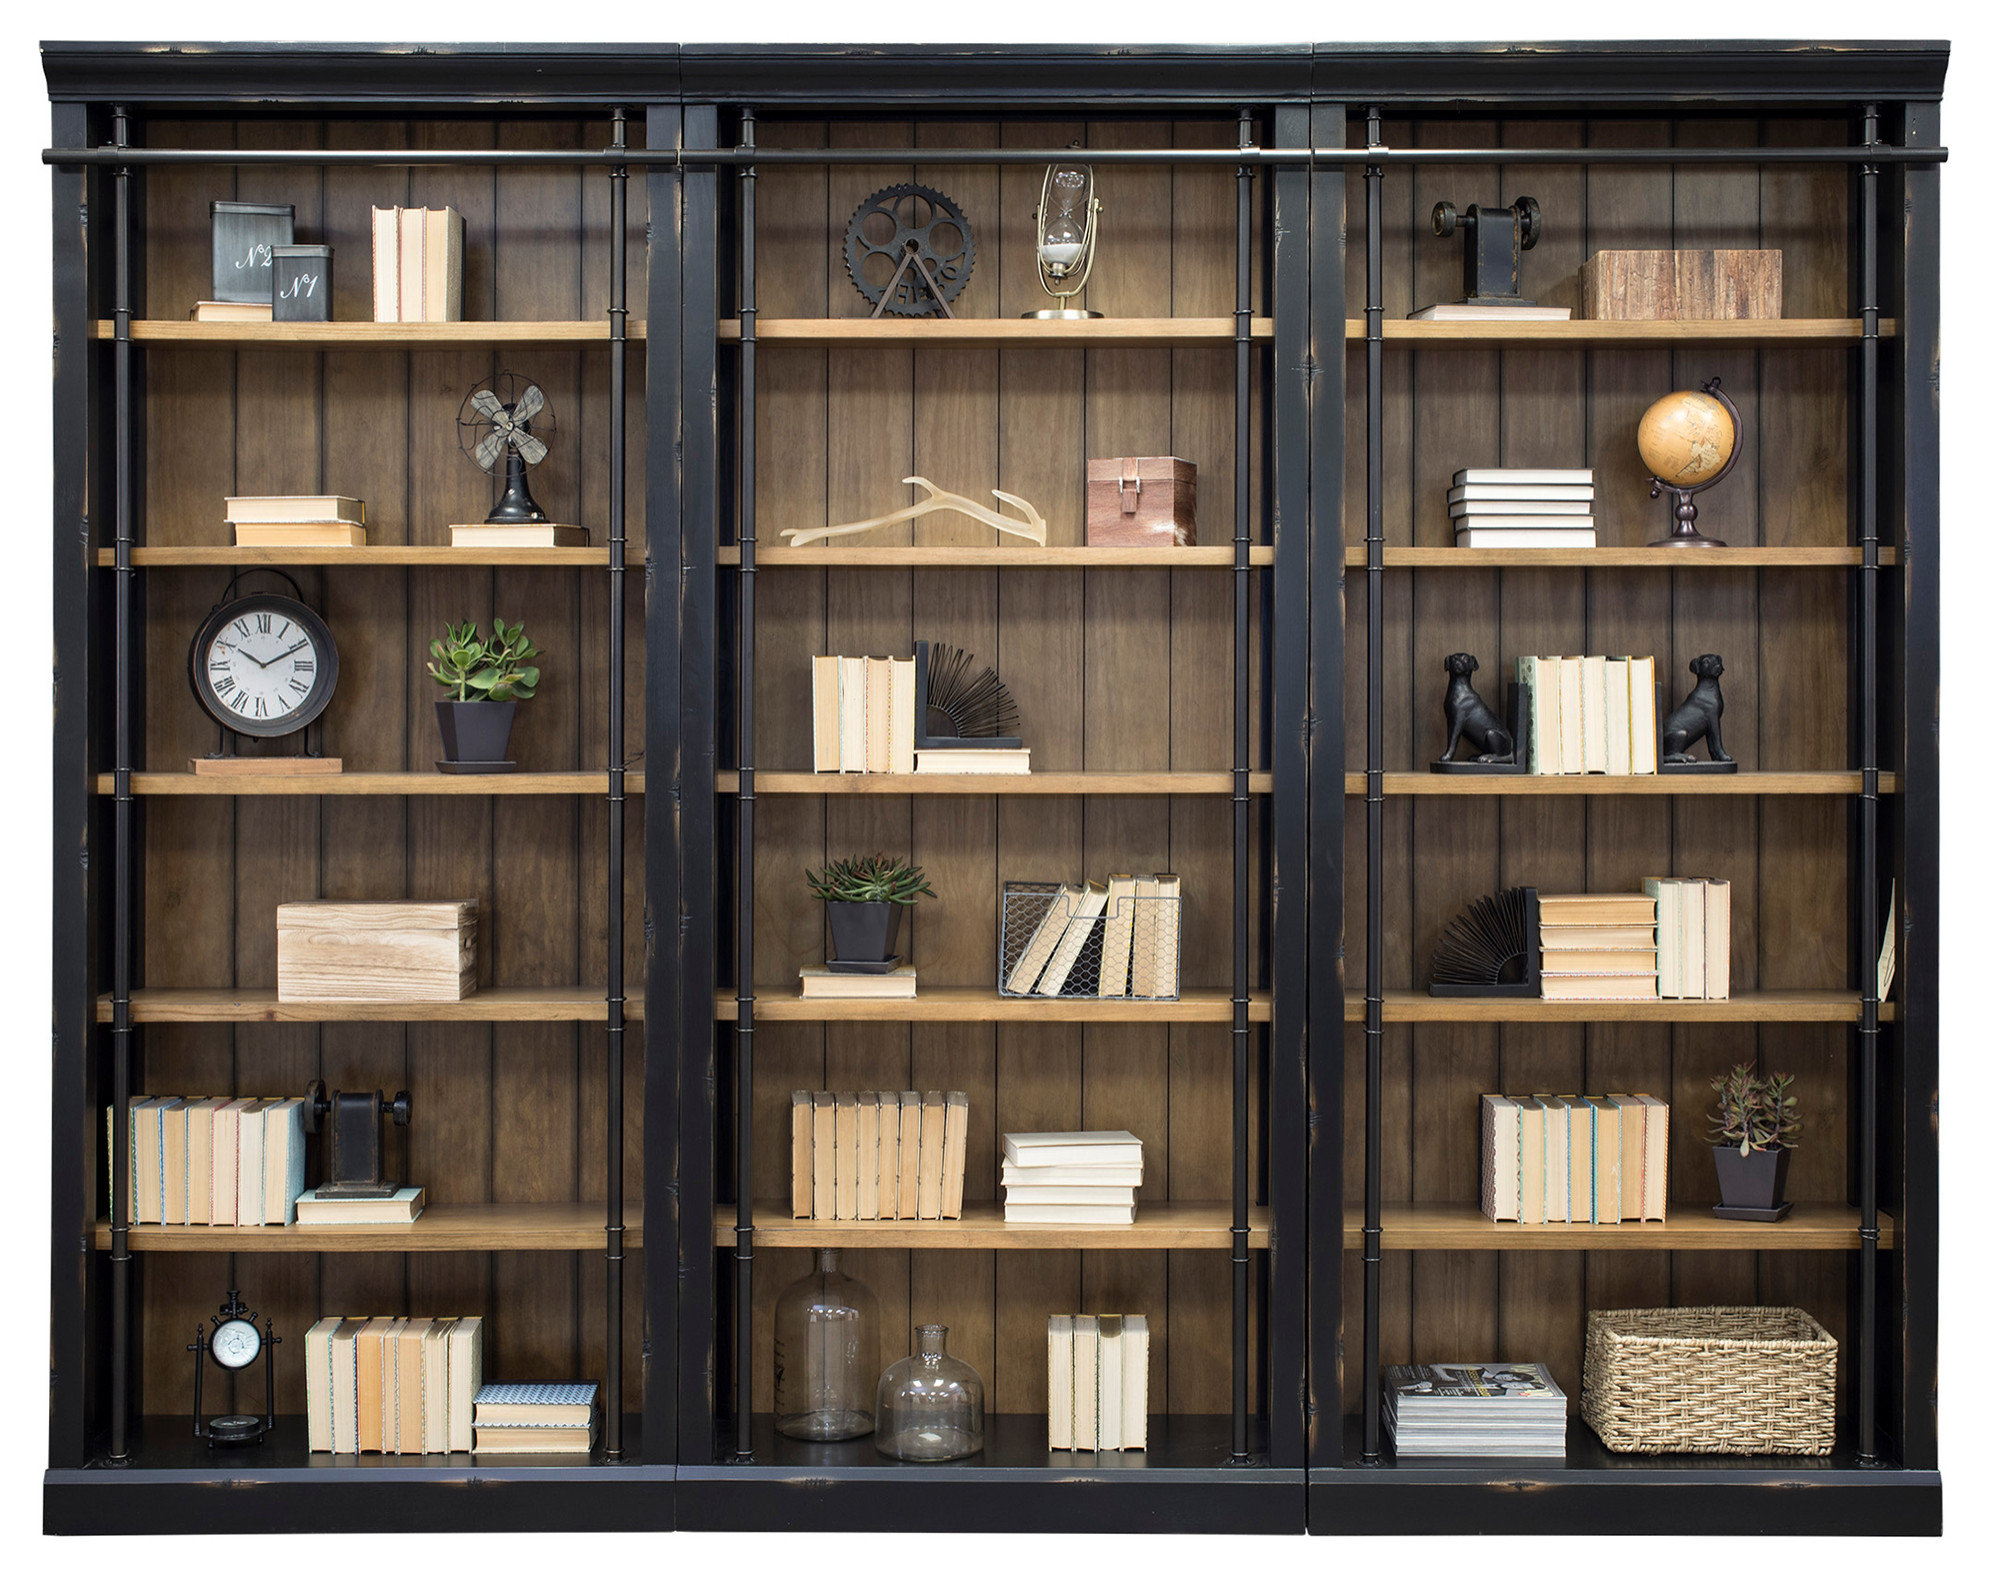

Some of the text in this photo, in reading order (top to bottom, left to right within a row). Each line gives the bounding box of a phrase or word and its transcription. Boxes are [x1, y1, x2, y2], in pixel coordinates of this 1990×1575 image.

[233, 618, 251, 641] XI
[256, 614, 272, 634] XII
[293, 658, 315, 673] III
